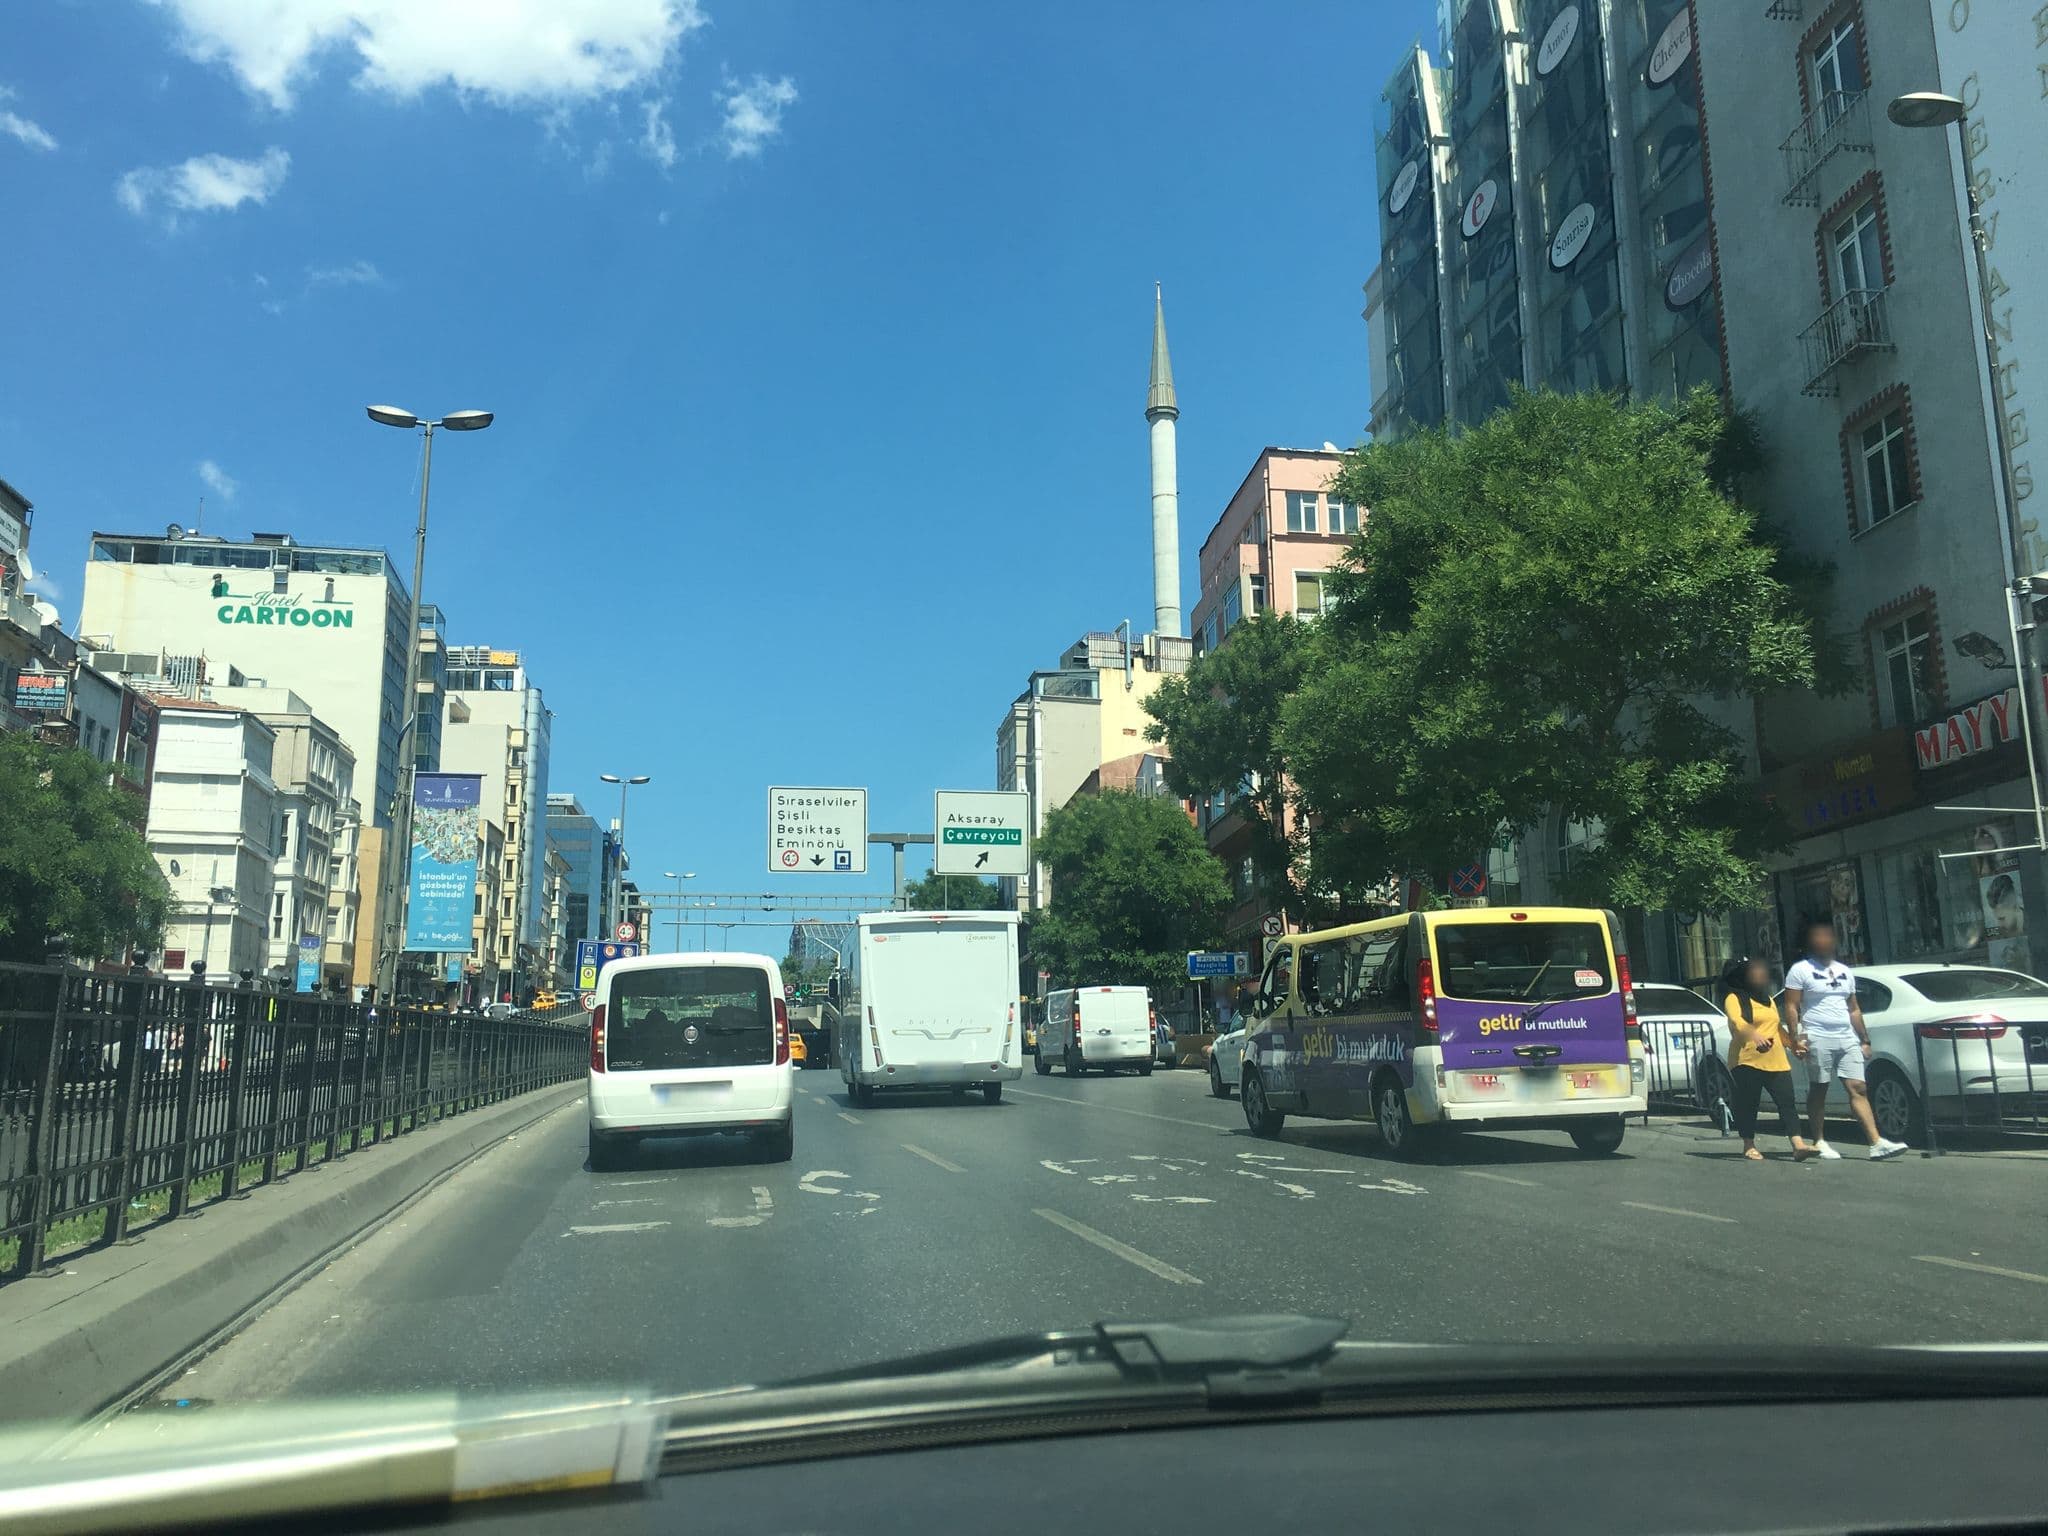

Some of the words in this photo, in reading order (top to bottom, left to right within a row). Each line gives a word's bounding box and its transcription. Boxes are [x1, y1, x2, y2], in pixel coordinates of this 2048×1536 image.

[1546, 21, 1571, 59] Amor
[1653, 25, 1691, 73] Chéver
[1556, 214, 1590, 257] Sonrisa
[1669, 249, 1712, 297] Chocola
[251, 591, 303, 607] Hotel
[217, 605, 353, 628] CARTOON
[1915, 688, 2020, 770] MAYY
[777, 795, 858, 807] Sıraselviler
[947, 813, 1005, 827] Aksaray
[777, 824, 842, 835] Beşiktaş
[946, 829, 1019, 843] Çevreyolu
[776, 838, 845, 849] Eminönü
[419, 870, 468, 881] İstanbul'un
[419, 881, 466, 891] gözbebeği
[420, 890, 465, 898] cebinizde!
[1479, 1013, 1522, 1036] getir
[1538, 1017, 1588, 1030] mutluluk
[1302, 1026, 1334, 1067] getir
[1335, 1032, 1350, 1060] bi
[1350, 1032, 1406, 1061] mutluluk
